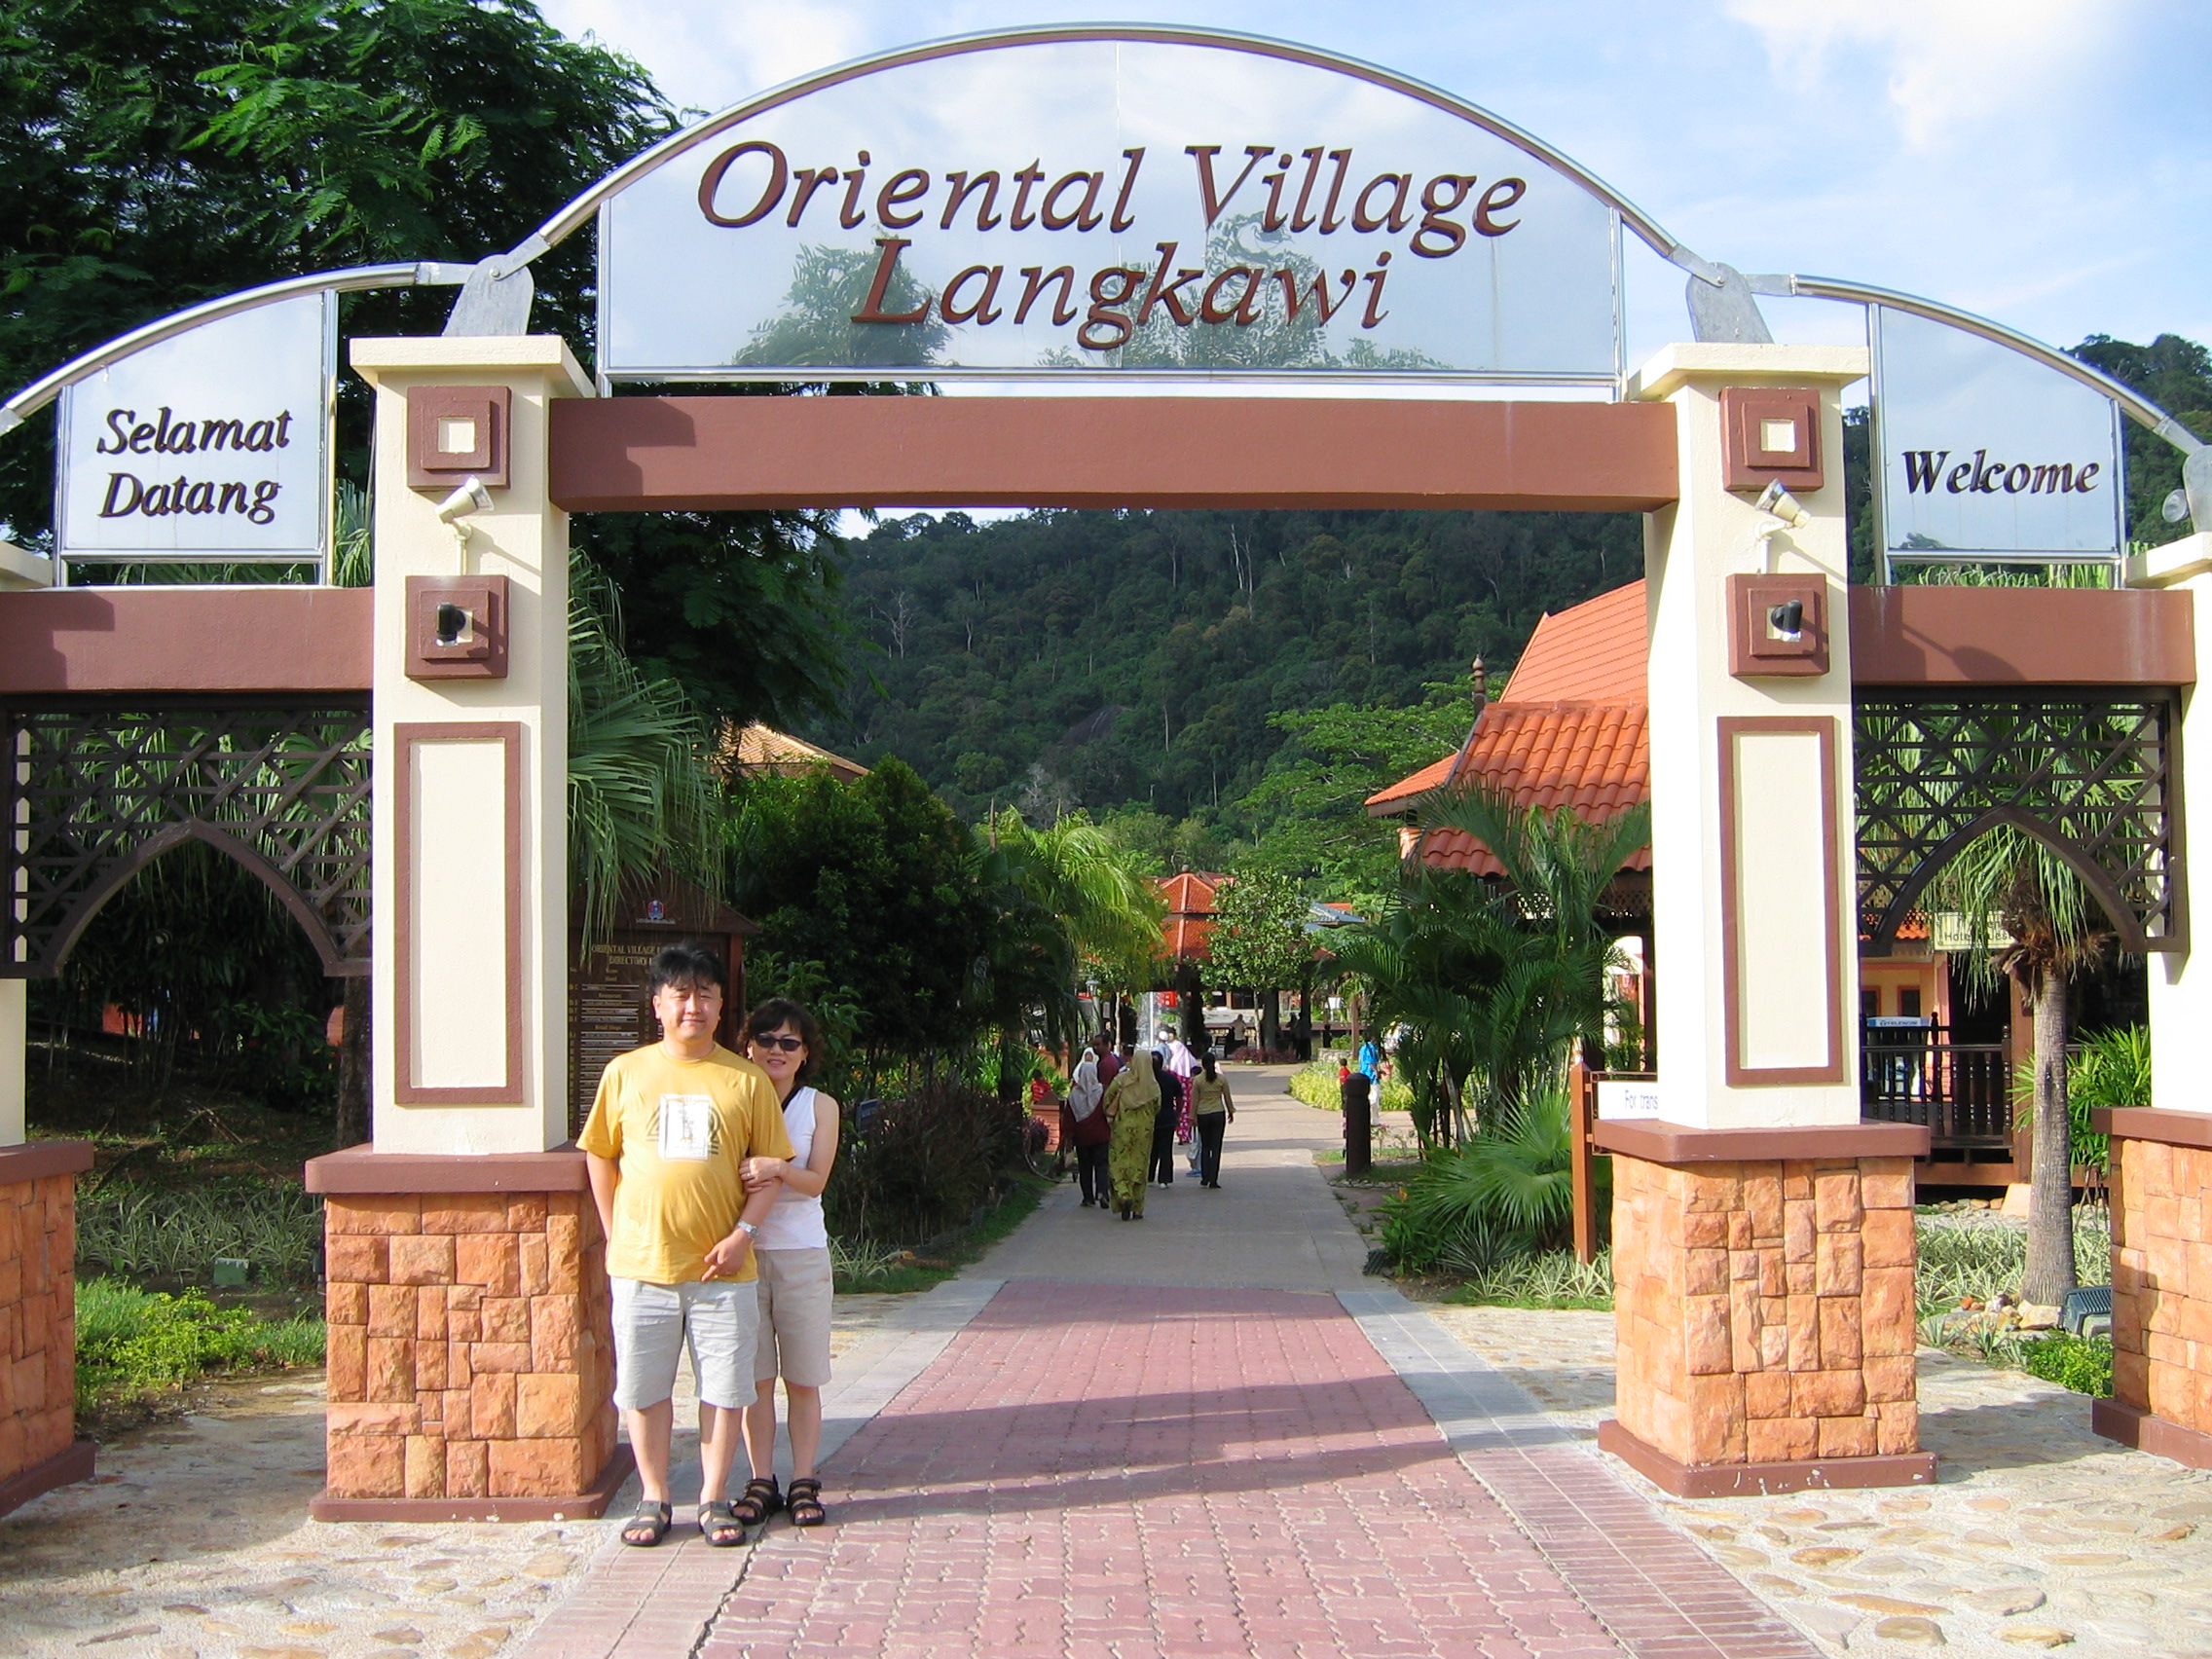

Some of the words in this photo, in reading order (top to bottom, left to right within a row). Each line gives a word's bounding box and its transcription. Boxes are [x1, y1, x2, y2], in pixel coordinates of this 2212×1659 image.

[697, 140, 1146, 233] Oriental
[1184, 144, 1527, 258] Village
[850, 238, 1391, 350] Langkawi
[96, 406, 293, 455] Selamat
[1900, 449, 2100, 495] Welcome
[97, 472, 282, 525] Datang
[591, 943, 626, 954] ORIENTAL
[627, 944, 656, 955] VILLAGE
